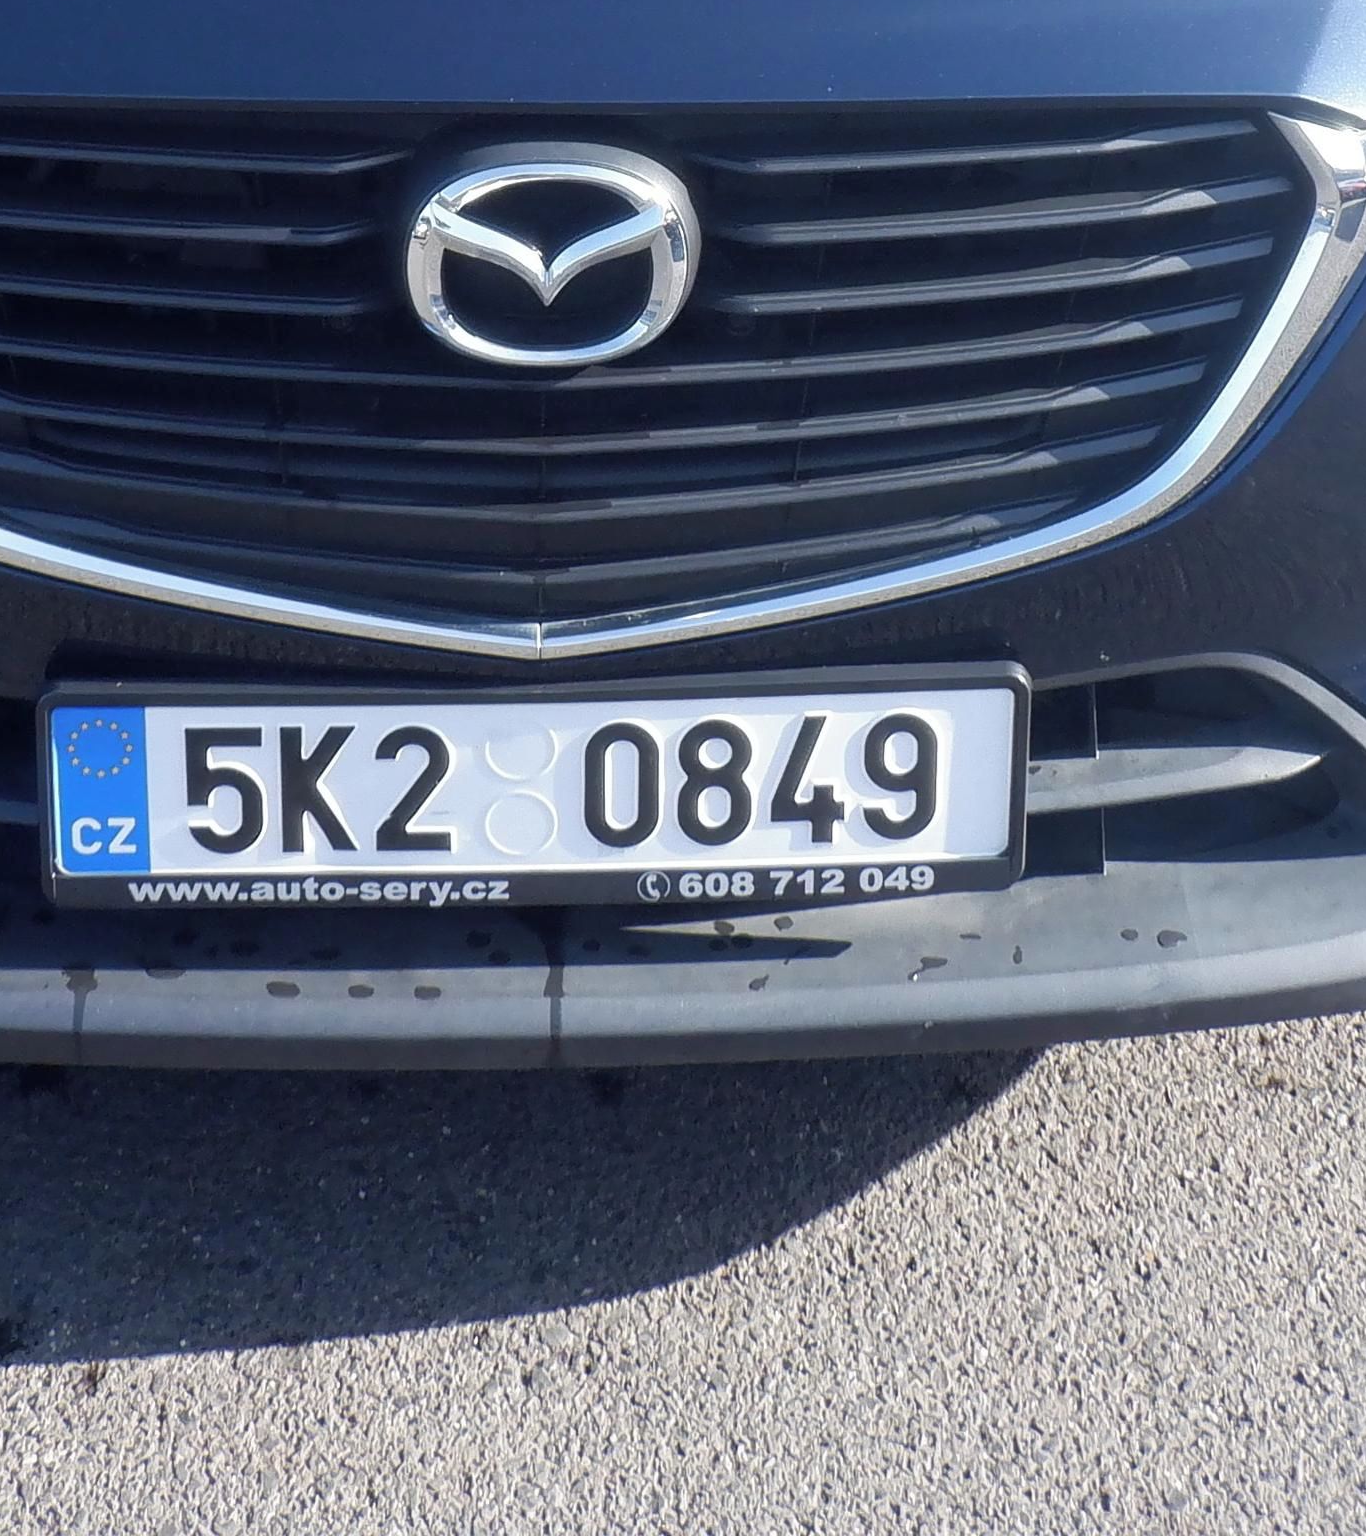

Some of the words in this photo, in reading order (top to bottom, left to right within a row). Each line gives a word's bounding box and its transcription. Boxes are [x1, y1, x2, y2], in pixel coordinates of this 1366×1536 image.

[184, 725, 453, 854] 5K2
[583, 712, 938, 848] 0849
[71, 817, 137, 855] CZ
[128, 876, 510, 907] www.auto-sery.cz
[678, 870, 755, 898] 608
[770, 869, 845, 896] 712
[860, 865, 935, 892] 049
